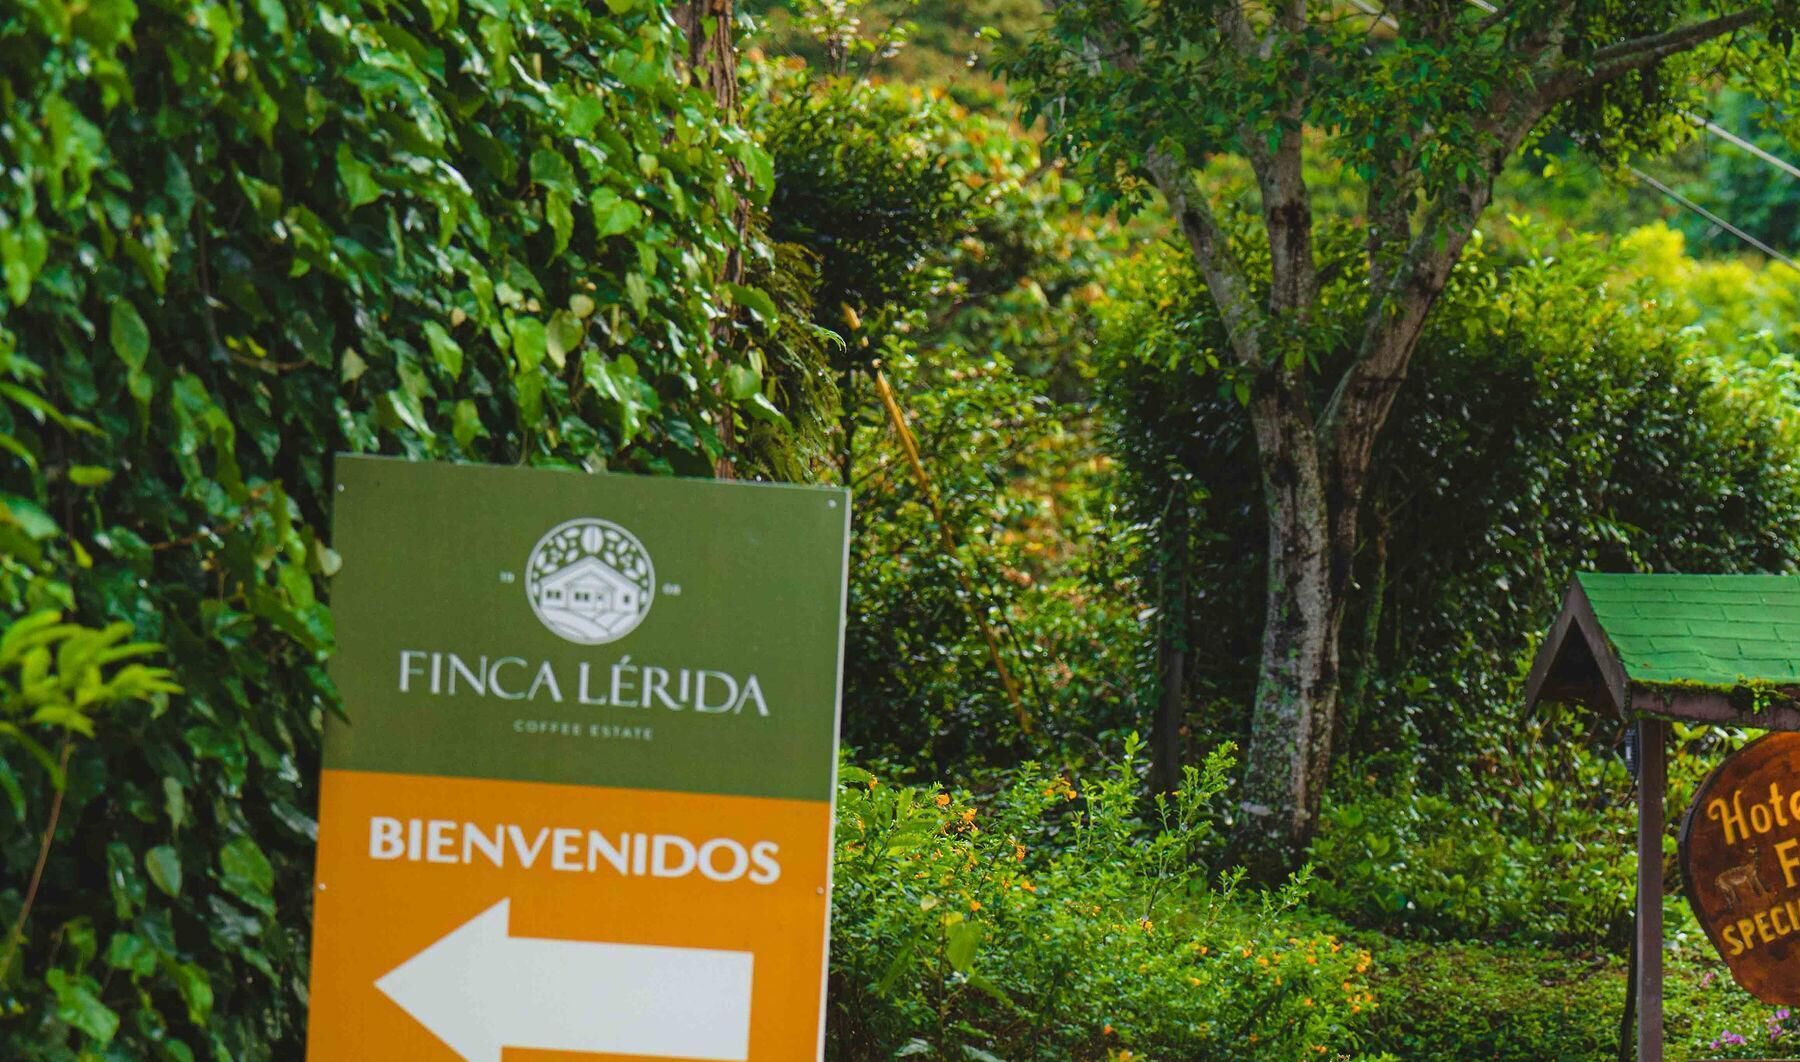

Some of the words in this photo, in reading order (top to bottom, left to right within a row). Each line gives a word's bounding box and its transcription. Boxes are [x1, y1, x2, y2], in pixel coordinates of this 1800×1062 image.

[398, 650, 563, 703] FINCA
[577, 655, 771, 717] LÉRIDA
[513, 719, 581, 737] COFFEE
[589, 724, 654, 742] ESTATE
[368, 816, 782, 885] BIENVENIDOS
